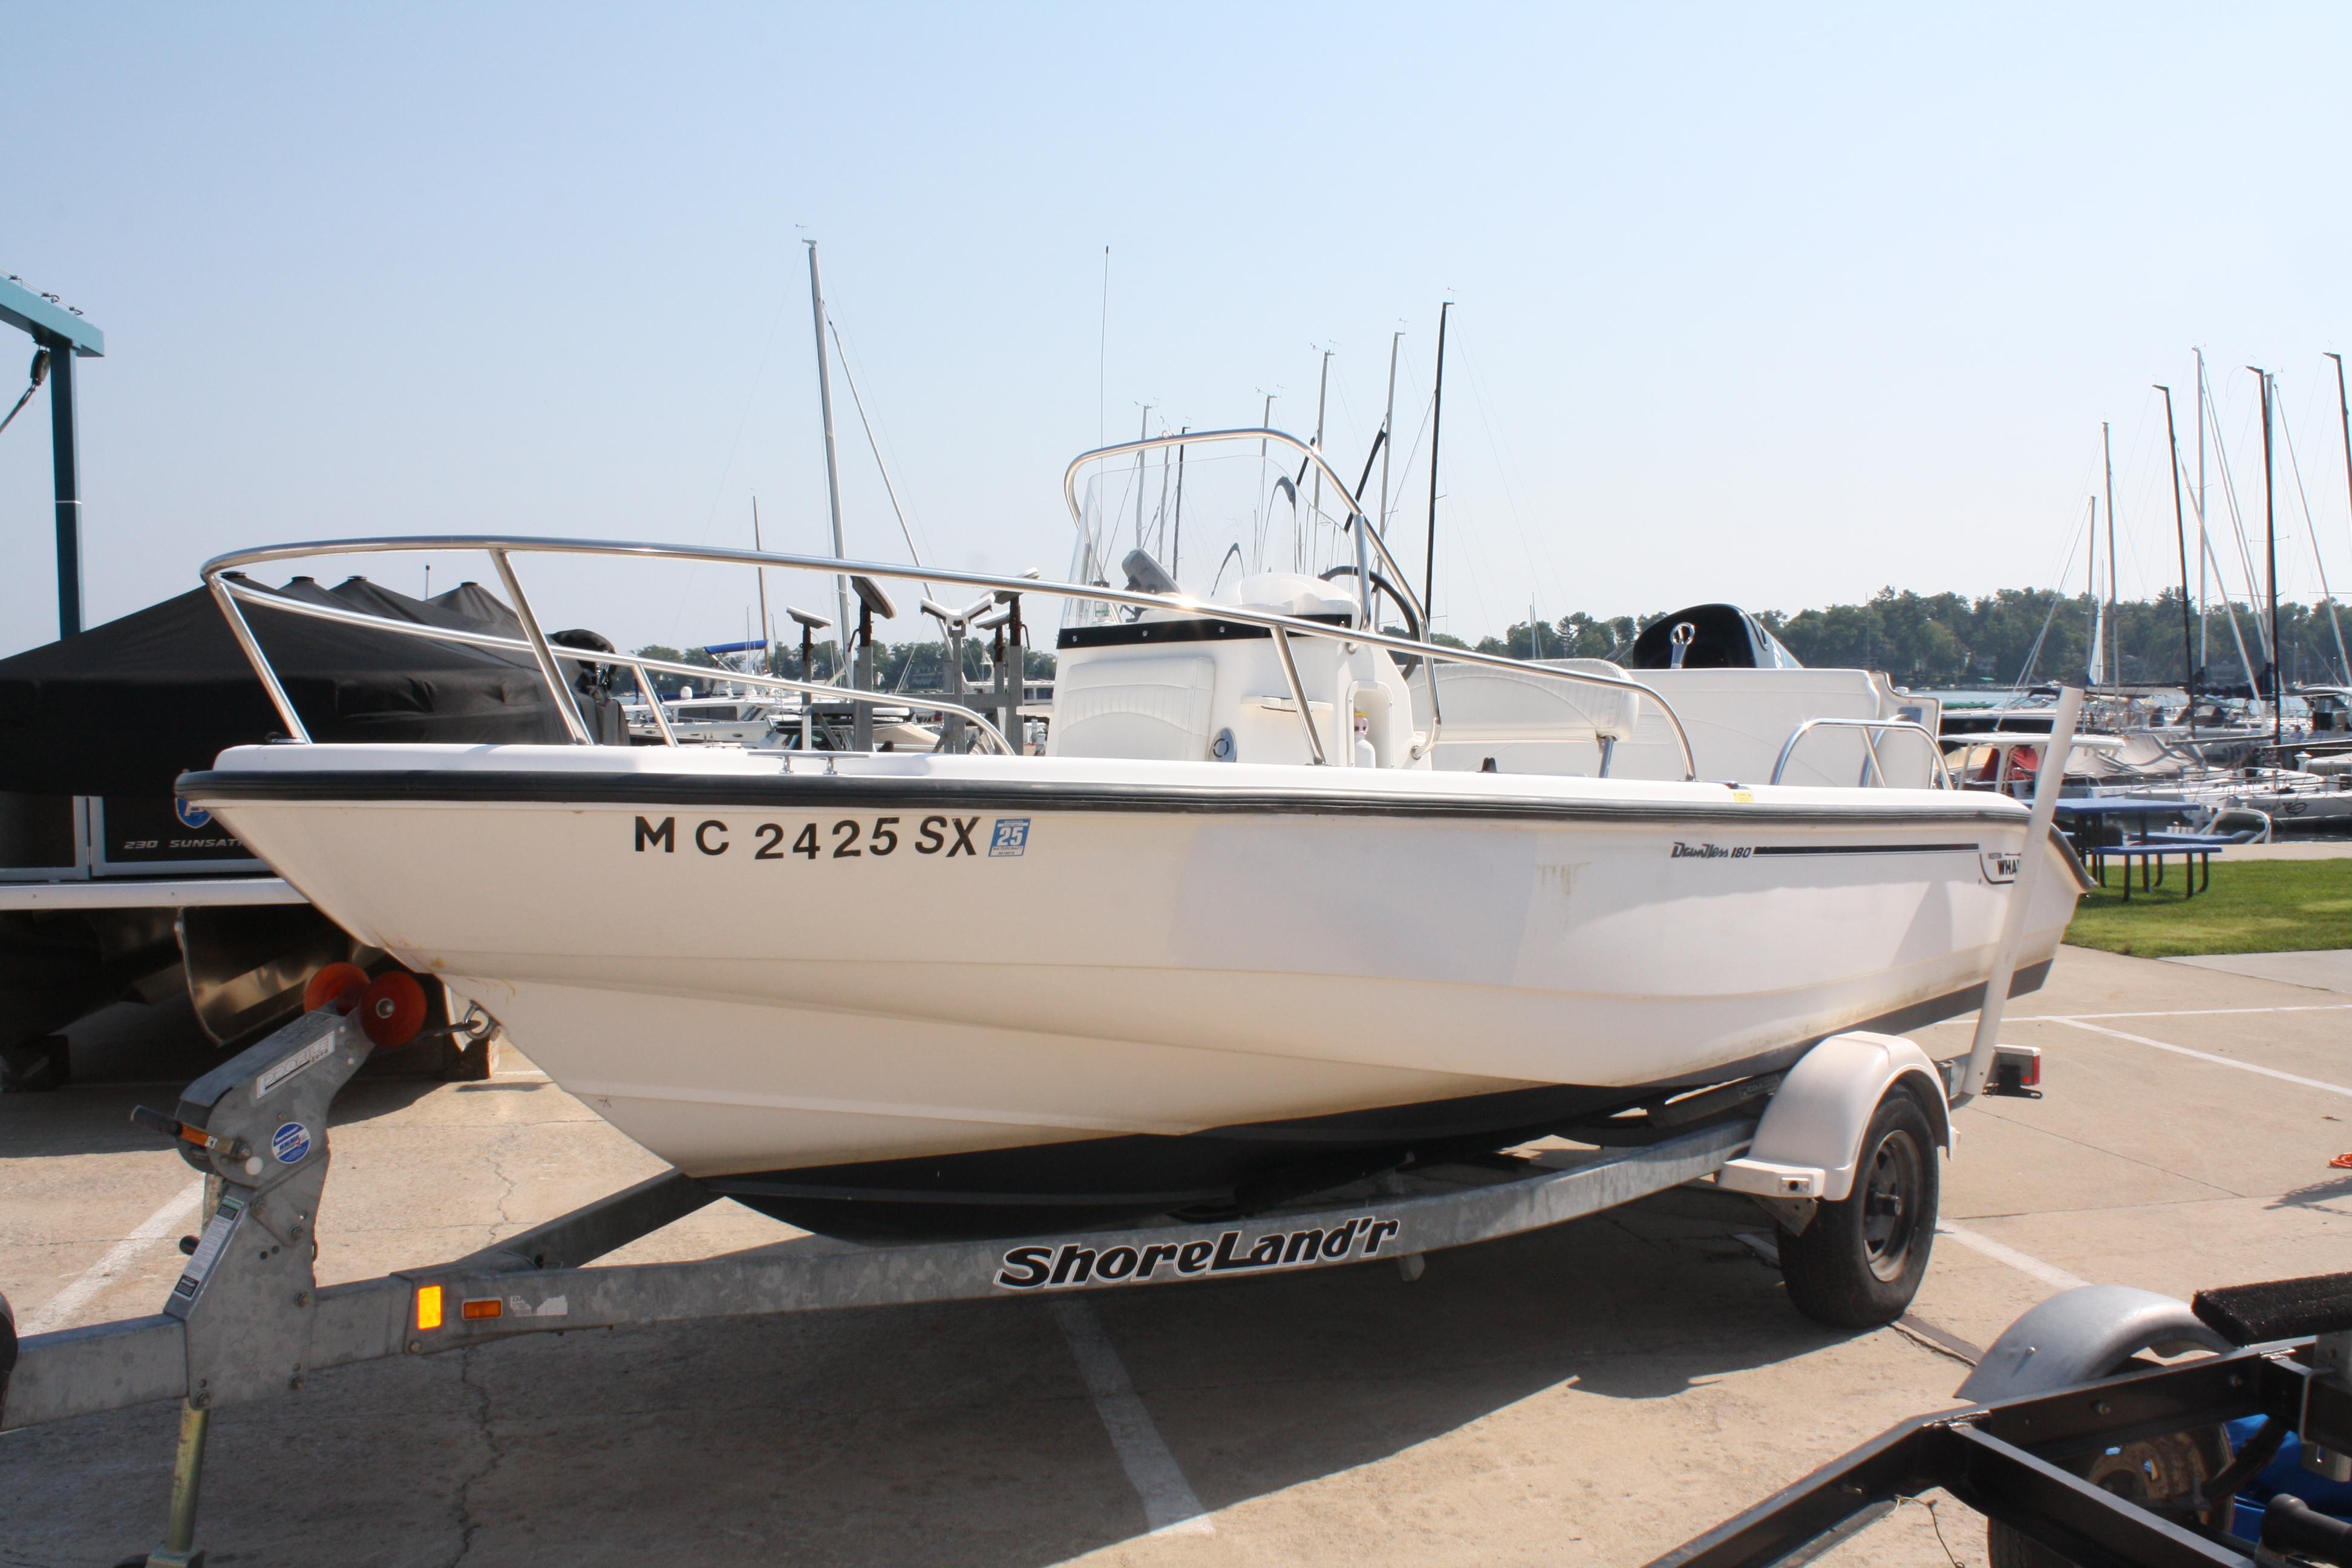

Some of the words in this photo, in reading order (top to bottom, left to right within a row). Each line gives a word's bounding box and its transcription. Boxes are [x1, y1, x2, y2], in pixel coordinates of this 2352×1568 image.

[124, 840, 158, 849] 230
[754, 817, 900, 860] 2425
[915, 815, 981, 858] SX
[997, 827, 1024, 846] 25
[1731, 847, 1752, 858] 180
[264, 1038, 329, 1086] PROFILE
[995, 1216, 1399, 1289] ShoreLand'r
